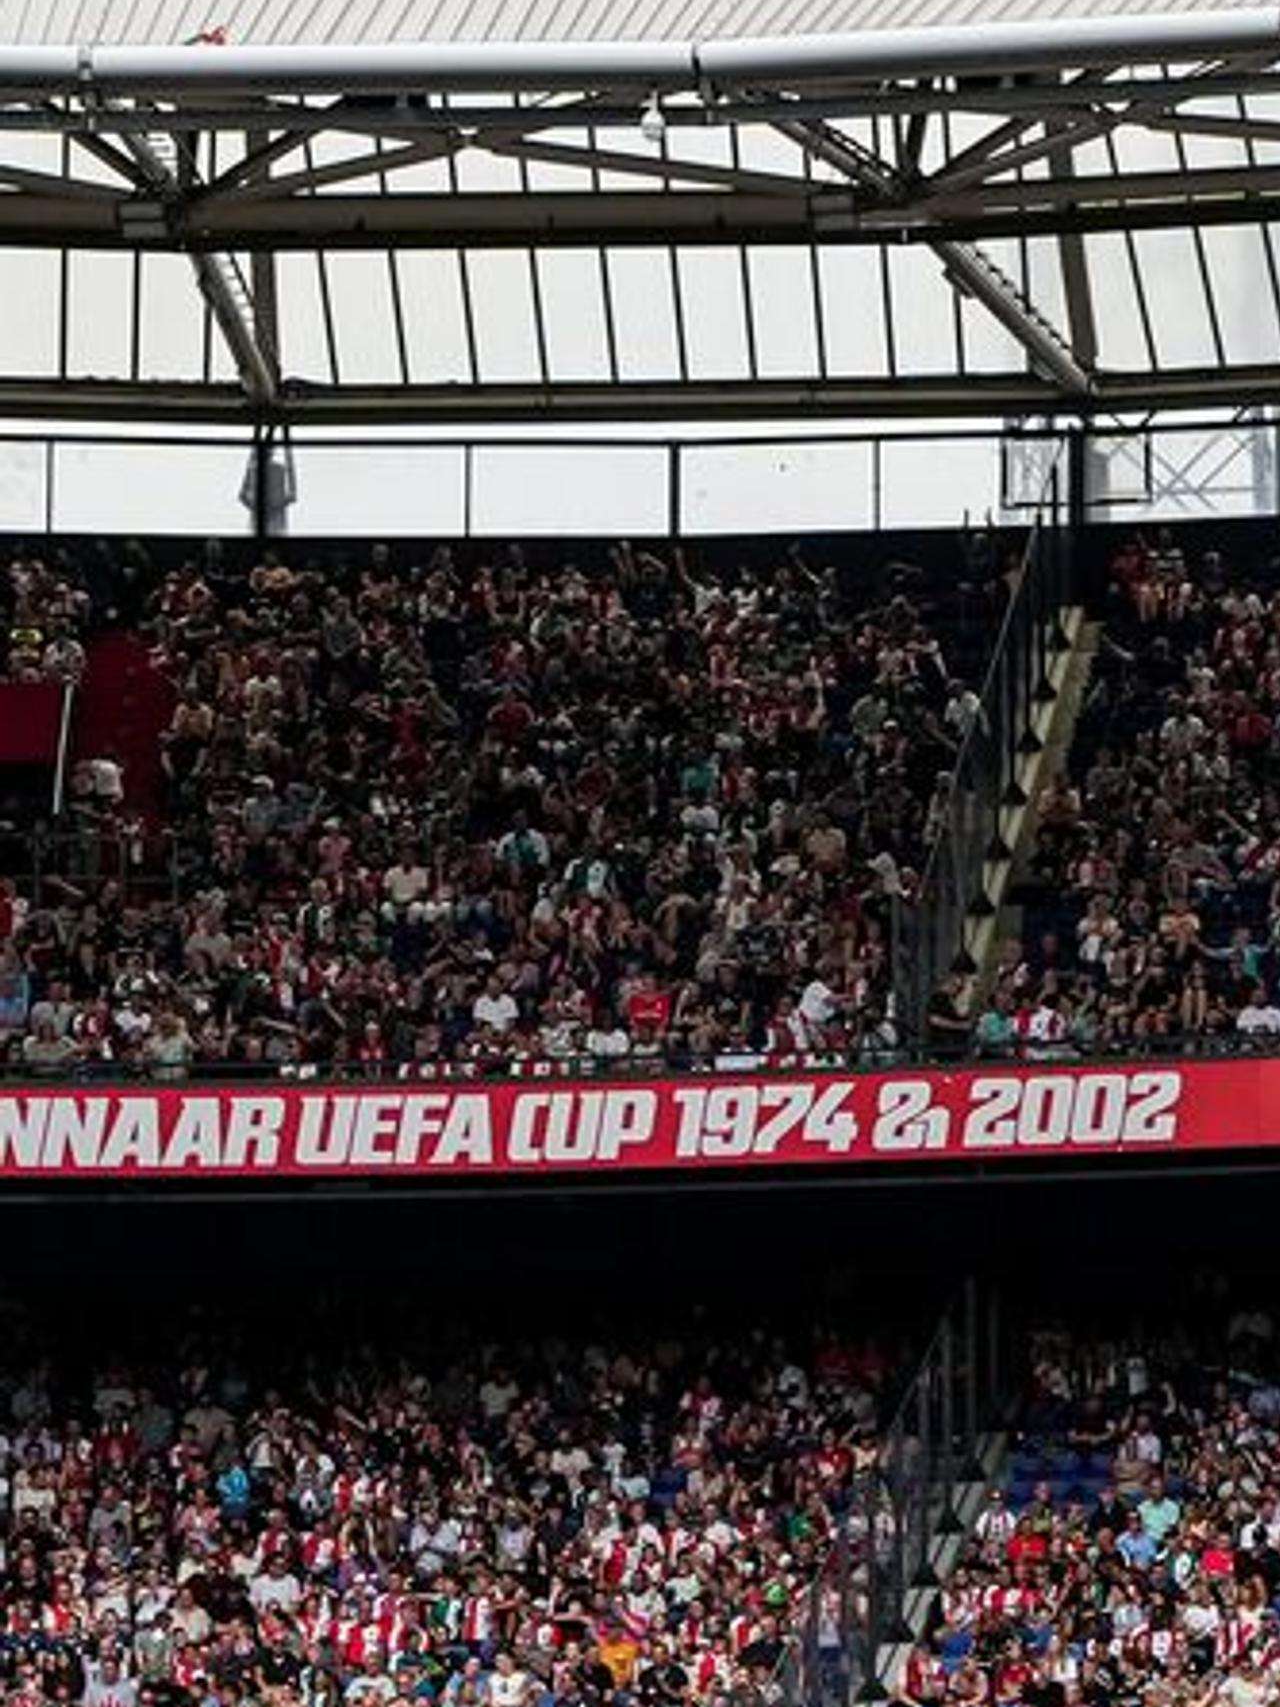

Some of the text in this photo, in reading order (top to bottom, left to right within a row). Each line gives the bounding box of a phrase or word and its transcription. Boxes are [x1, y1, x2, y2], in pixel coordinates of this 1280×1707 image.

[295, 1091, 492, 1165] UEFA
[506, 1089, 658, 1162] CUP
[672, 1082, 858, 1158] 1974
[963, 1071, 1181, 1148] 2002
